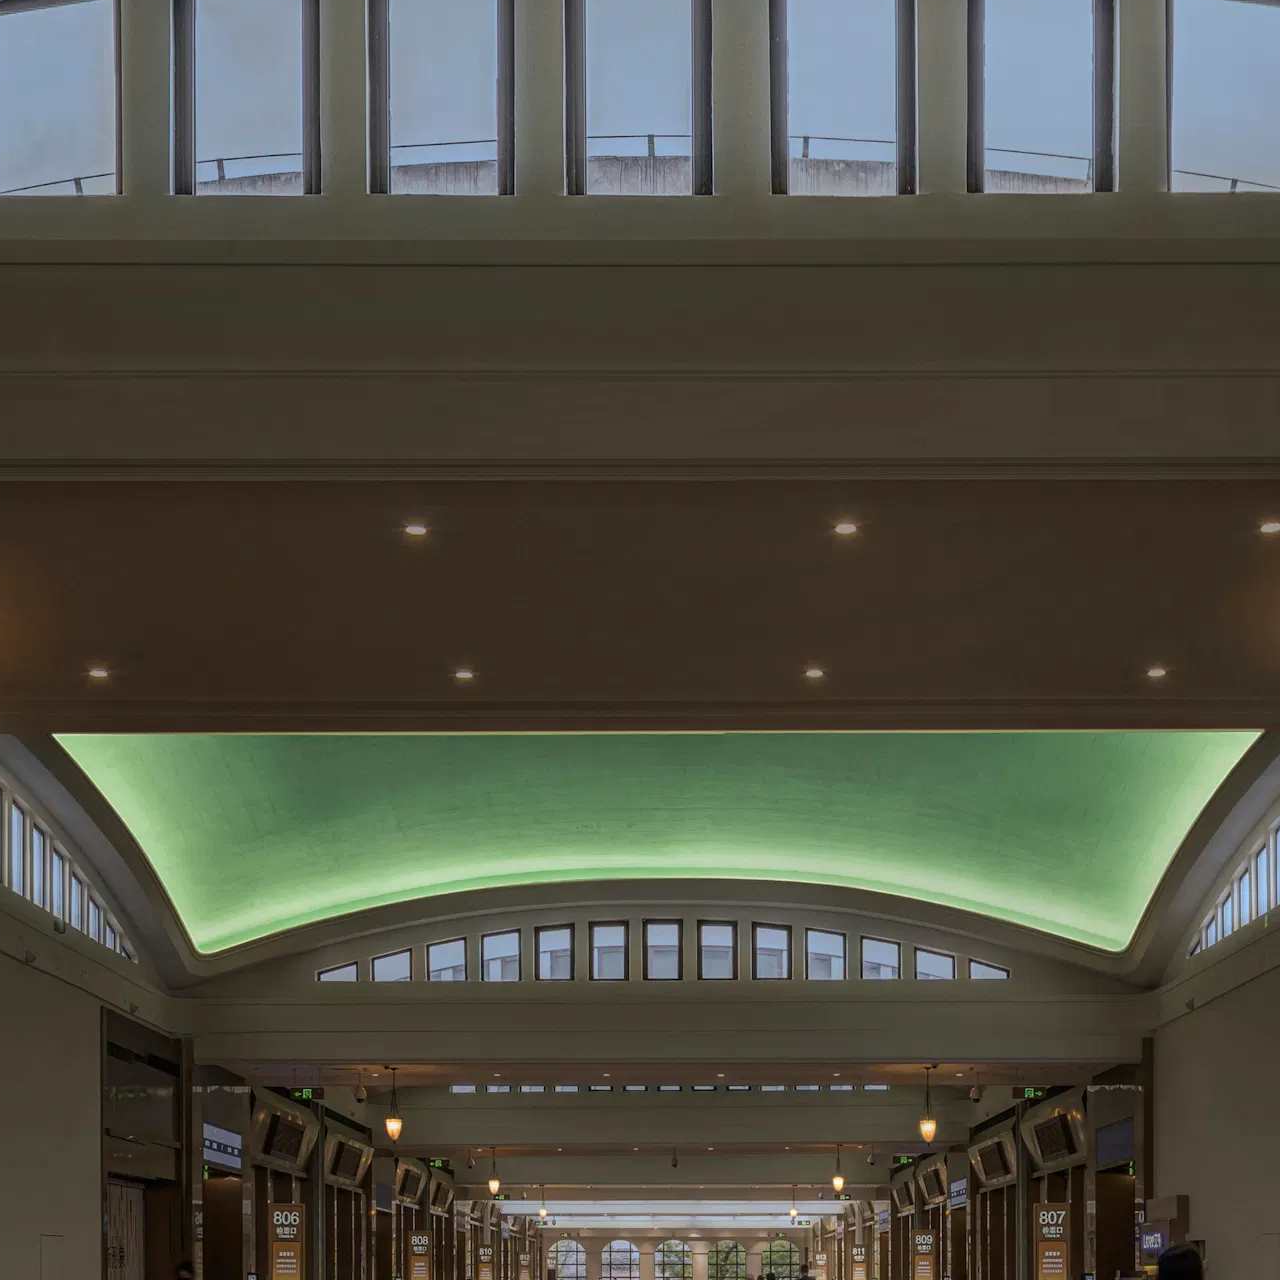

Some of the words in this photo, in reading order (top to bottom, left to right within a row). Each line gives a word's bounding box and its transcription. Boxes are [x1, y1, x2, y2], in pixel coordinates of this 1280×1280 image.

[273, 1210, 300, 1225] 806
[1039, 1210, 1066, 1225] 807
[411, 1235, 428, 1245] 808
[915, 1235, 933, 1244] 809
[852, 1247, 865, 1255] 811
